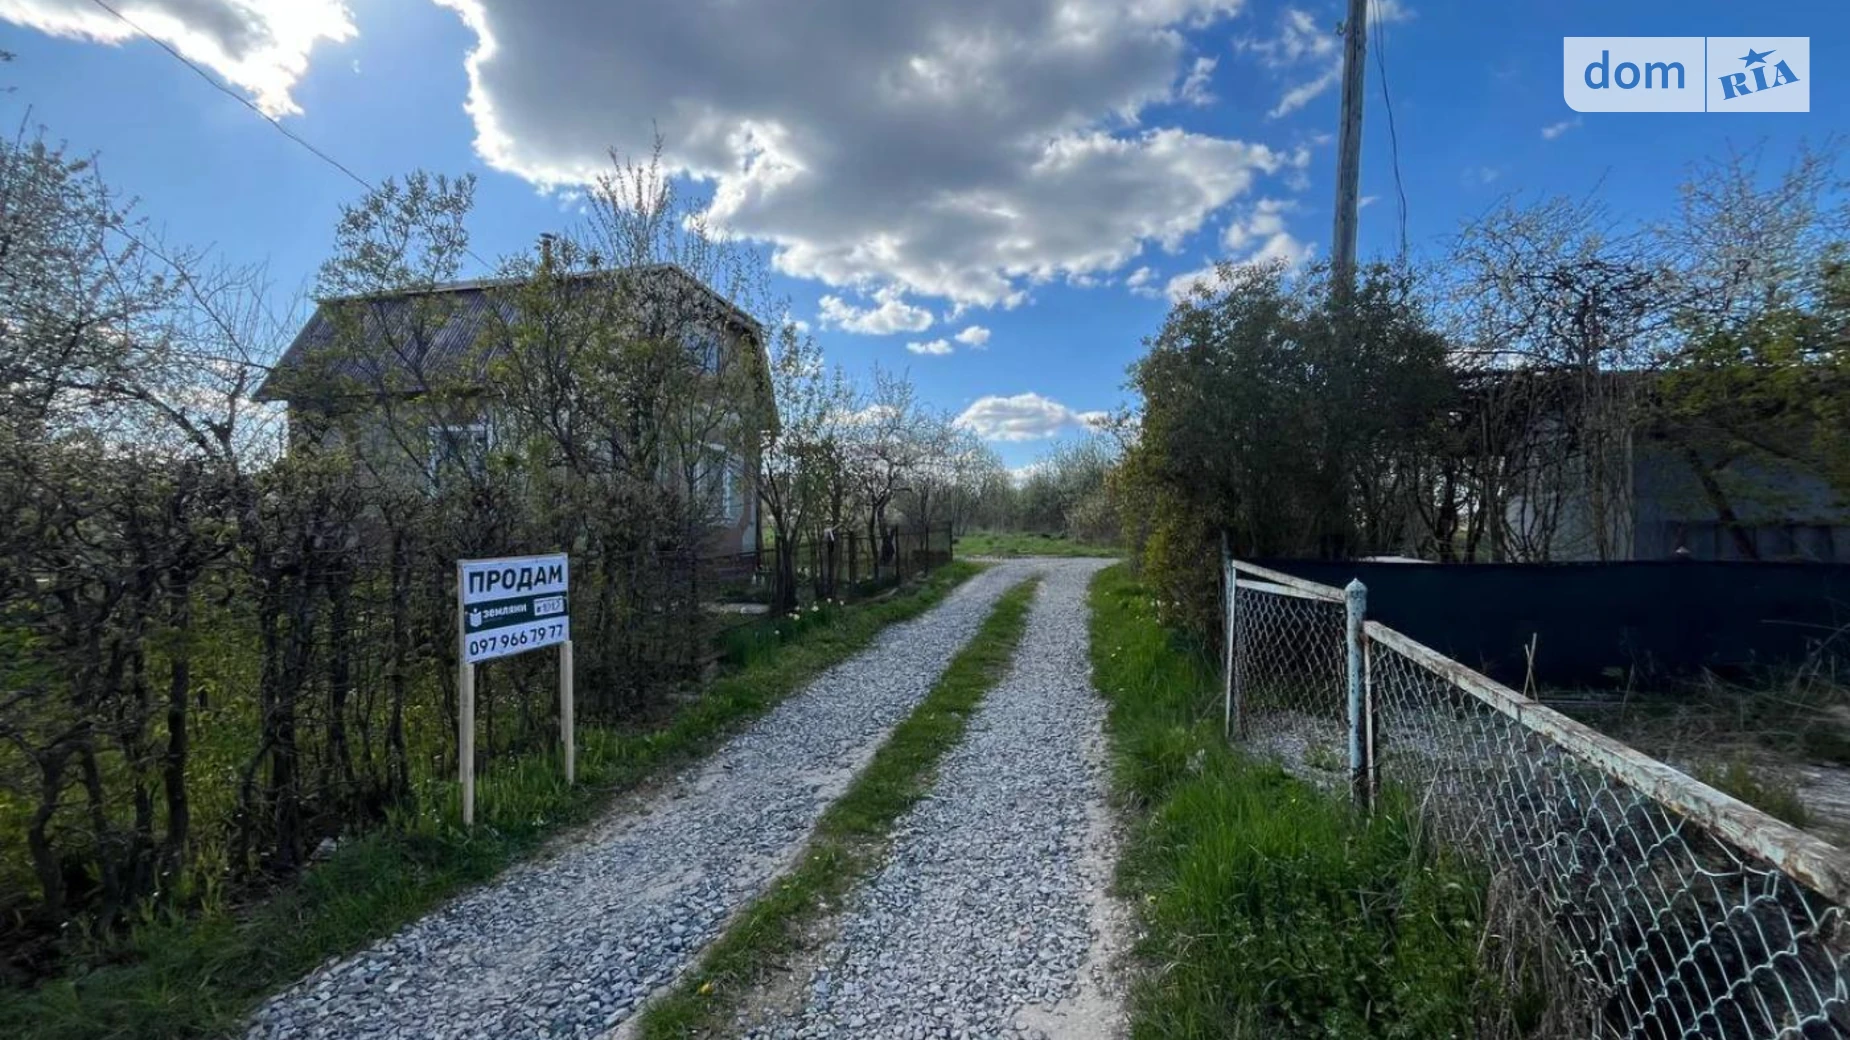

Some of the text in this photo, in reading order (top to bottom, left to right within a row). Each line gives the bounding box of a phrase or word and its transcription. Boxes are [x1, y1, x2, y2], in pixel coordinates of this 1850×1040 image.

[468, 564, 563, 594] ПРОДАМ
[469, 624, 563, 656] 097 966 79 77
